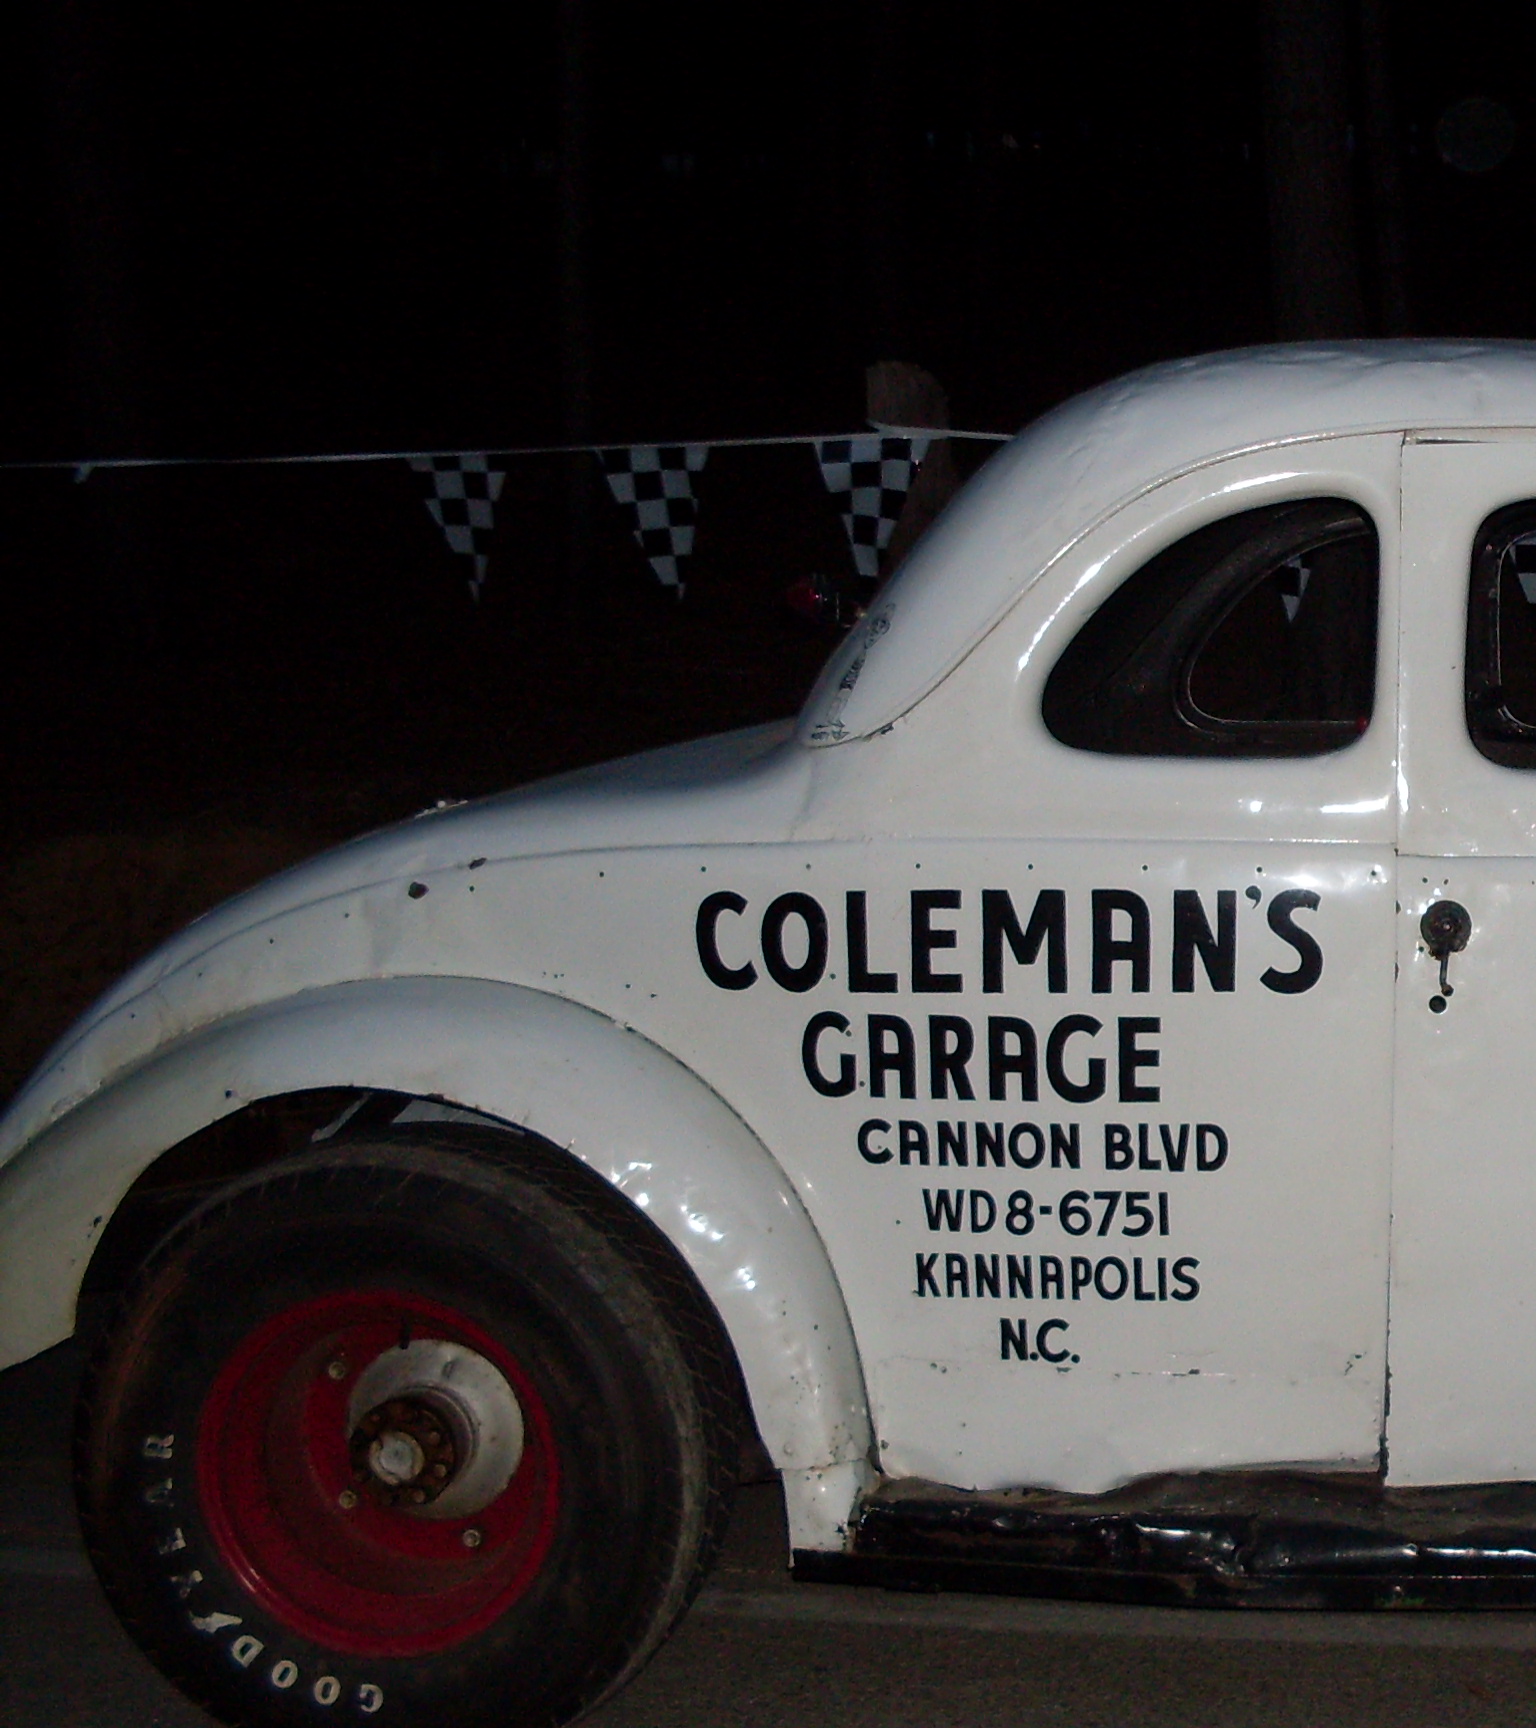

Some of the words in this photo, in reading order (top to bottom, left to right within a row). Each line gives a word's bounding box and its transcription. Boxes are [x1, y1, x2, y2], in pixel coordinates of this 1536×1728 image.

[695, 885, 1323, 994] COLEMAN'S
[801, 1010, 1161, 1103] GARAGE
[857, 1118, 1081, 1169] CANNON
[1104, 1123, 1228, 1172] BLVD
[916, 1252, 1200, 1302] KANNAPOLIS
[999, 1318, 1081, 1363] N.C.
